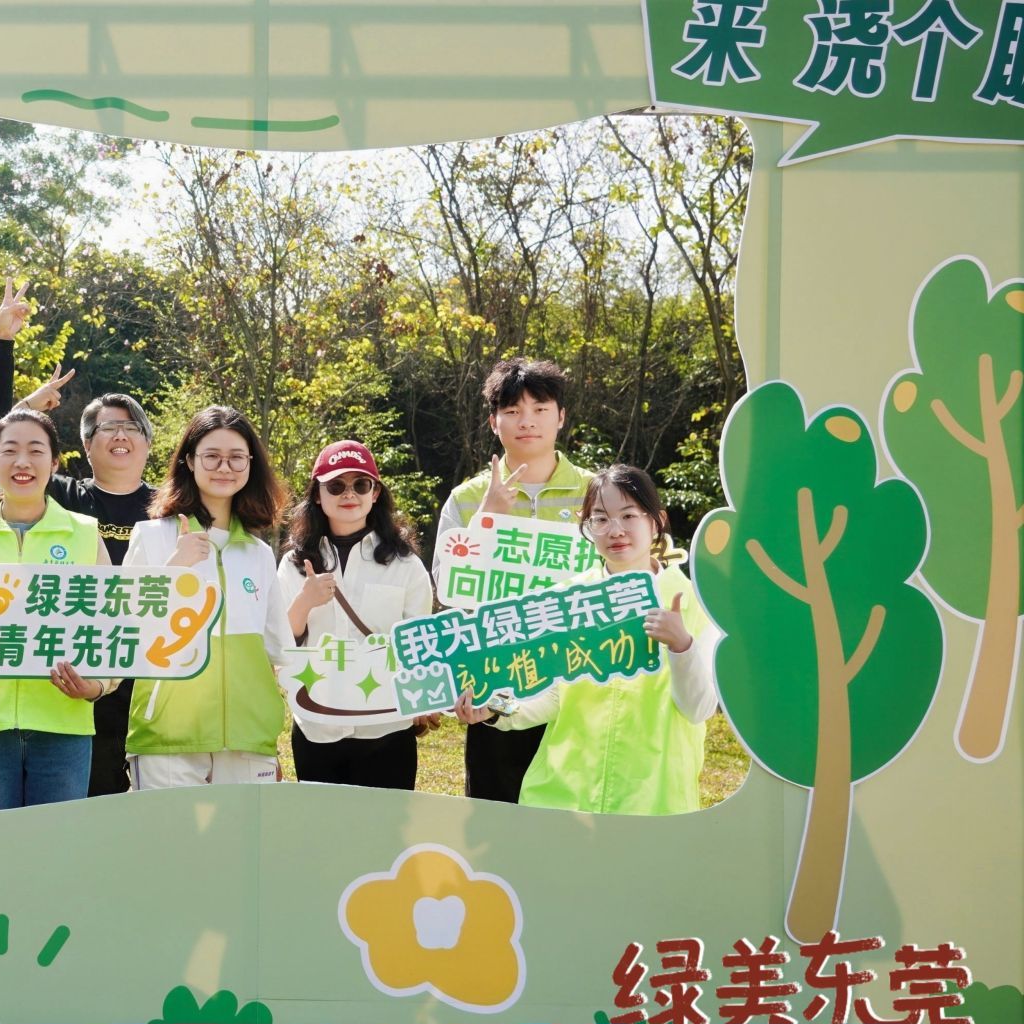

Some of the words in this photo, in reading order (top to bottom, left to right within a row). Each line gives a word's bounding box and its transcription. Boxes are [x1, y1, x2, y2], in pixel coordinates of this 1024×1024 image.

[24, 574, 173, 617] 绿美东莞
[399, 577, 651, 666] 我为绿美东莞
[610, 930, 974, 1024] 绿美东莞
